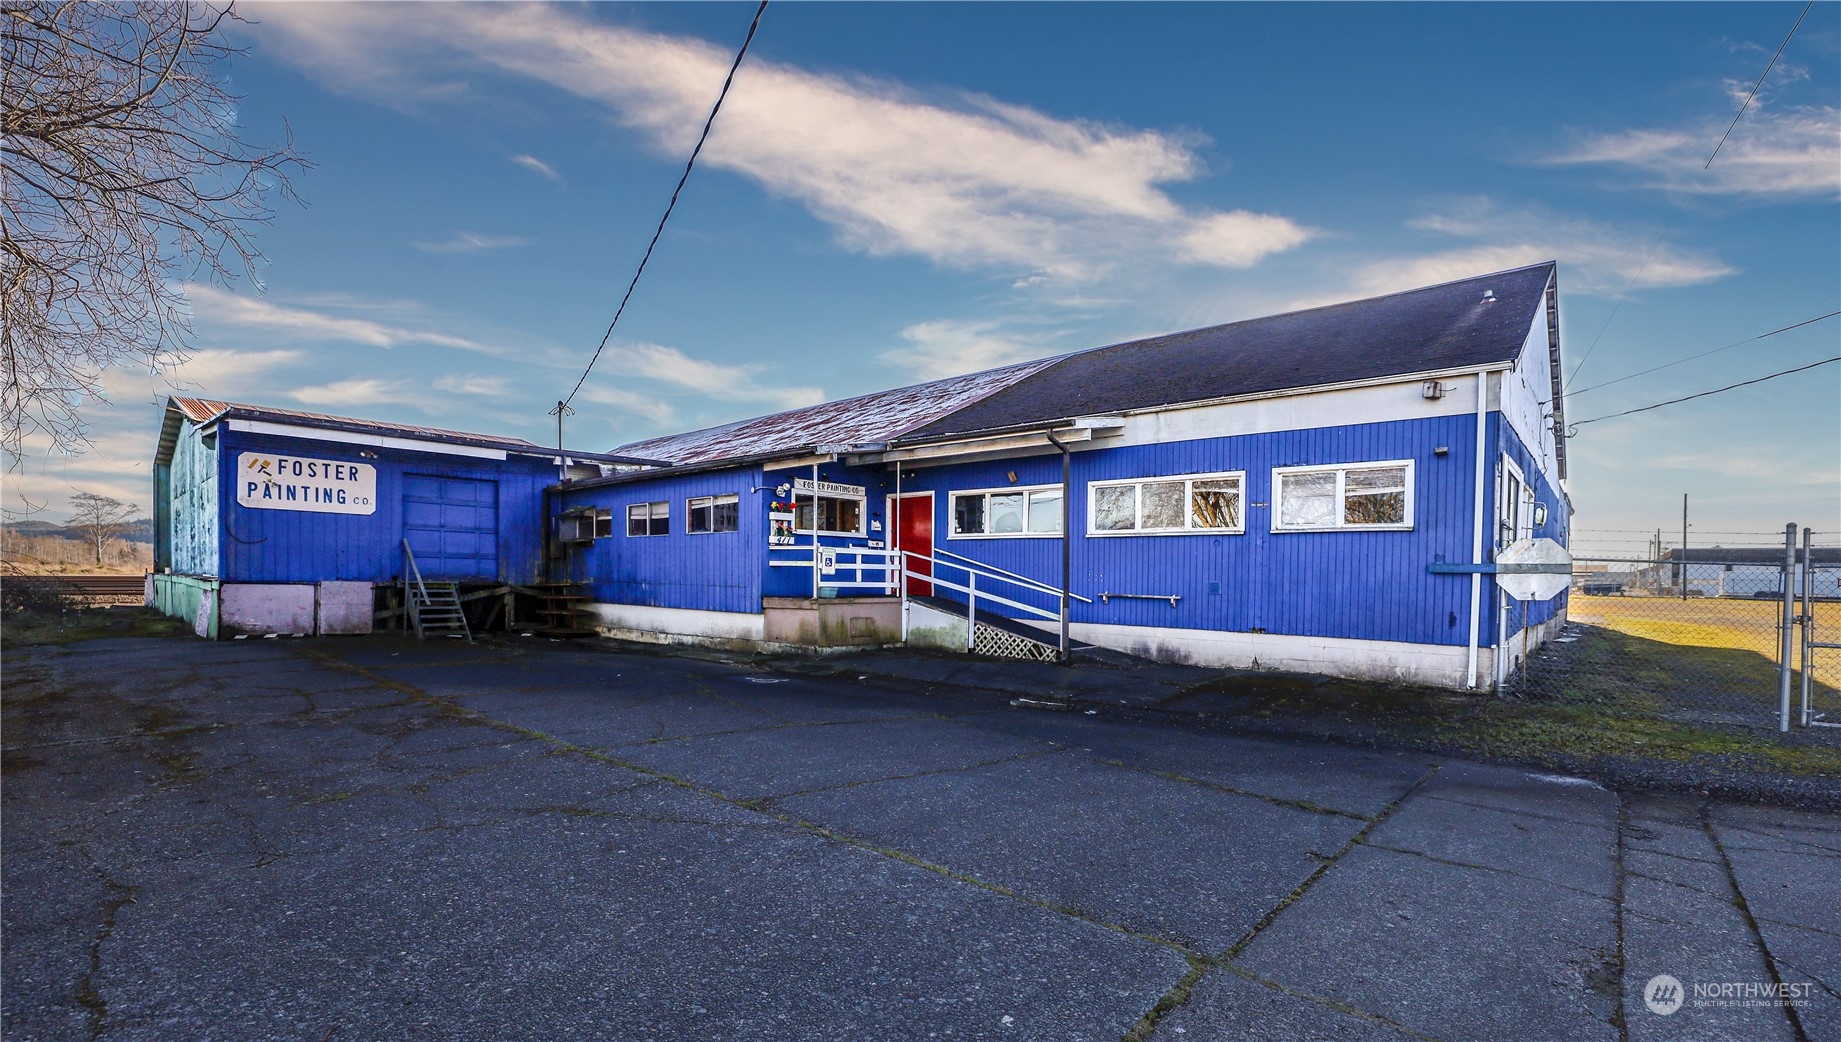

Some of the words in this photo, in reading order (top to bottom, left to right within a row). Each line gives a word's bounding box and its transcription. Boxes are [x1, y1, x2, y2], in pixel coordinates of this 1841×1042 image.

[278, 459, 359, 482] FOSTER
[247, 481, 347, 505] PAINTING
[803, 481, 826, 490] FOSER
[827, 483, 851, 494] PAINTING
